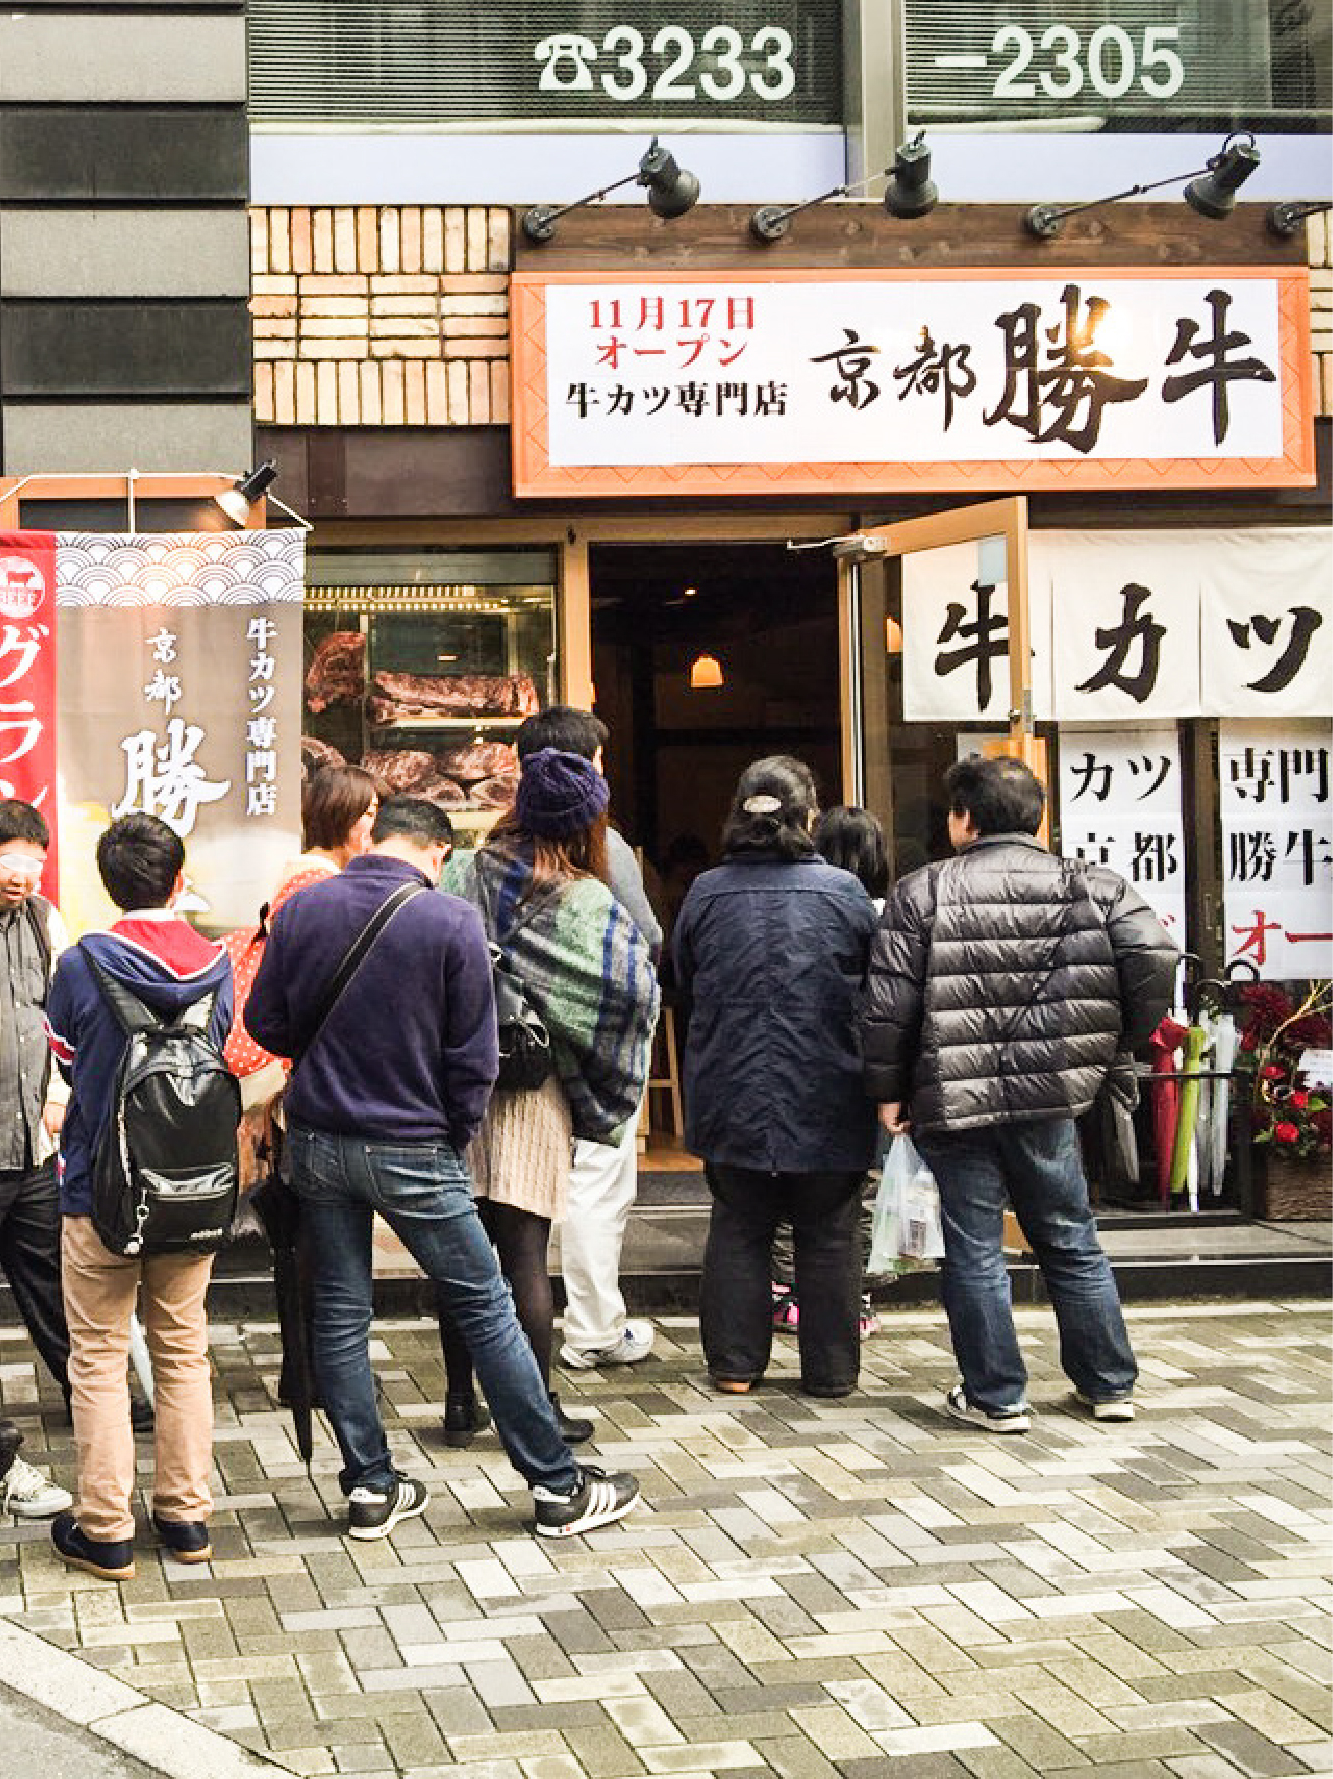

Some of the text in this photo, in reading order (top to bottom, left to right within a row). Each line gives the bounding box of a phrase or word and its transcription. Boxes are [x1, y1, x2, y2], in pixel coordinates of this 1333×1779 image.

[600, 25, 796, 101] 3233
[589, 297, 756, 331] 11月17日
[596, 336, 748, 369] オープン
[809, 283, 1277, 454] 京都勝牛
[565, 381, 788, 418] 牛カツ専門店
[934, 580, 1323, 712] 牛カツ
[246, 616, 278, 816] 牛カツ専門店
[1070, 752, 1172, 802] カツ
[1229, 747, 1330, 804] 専門
